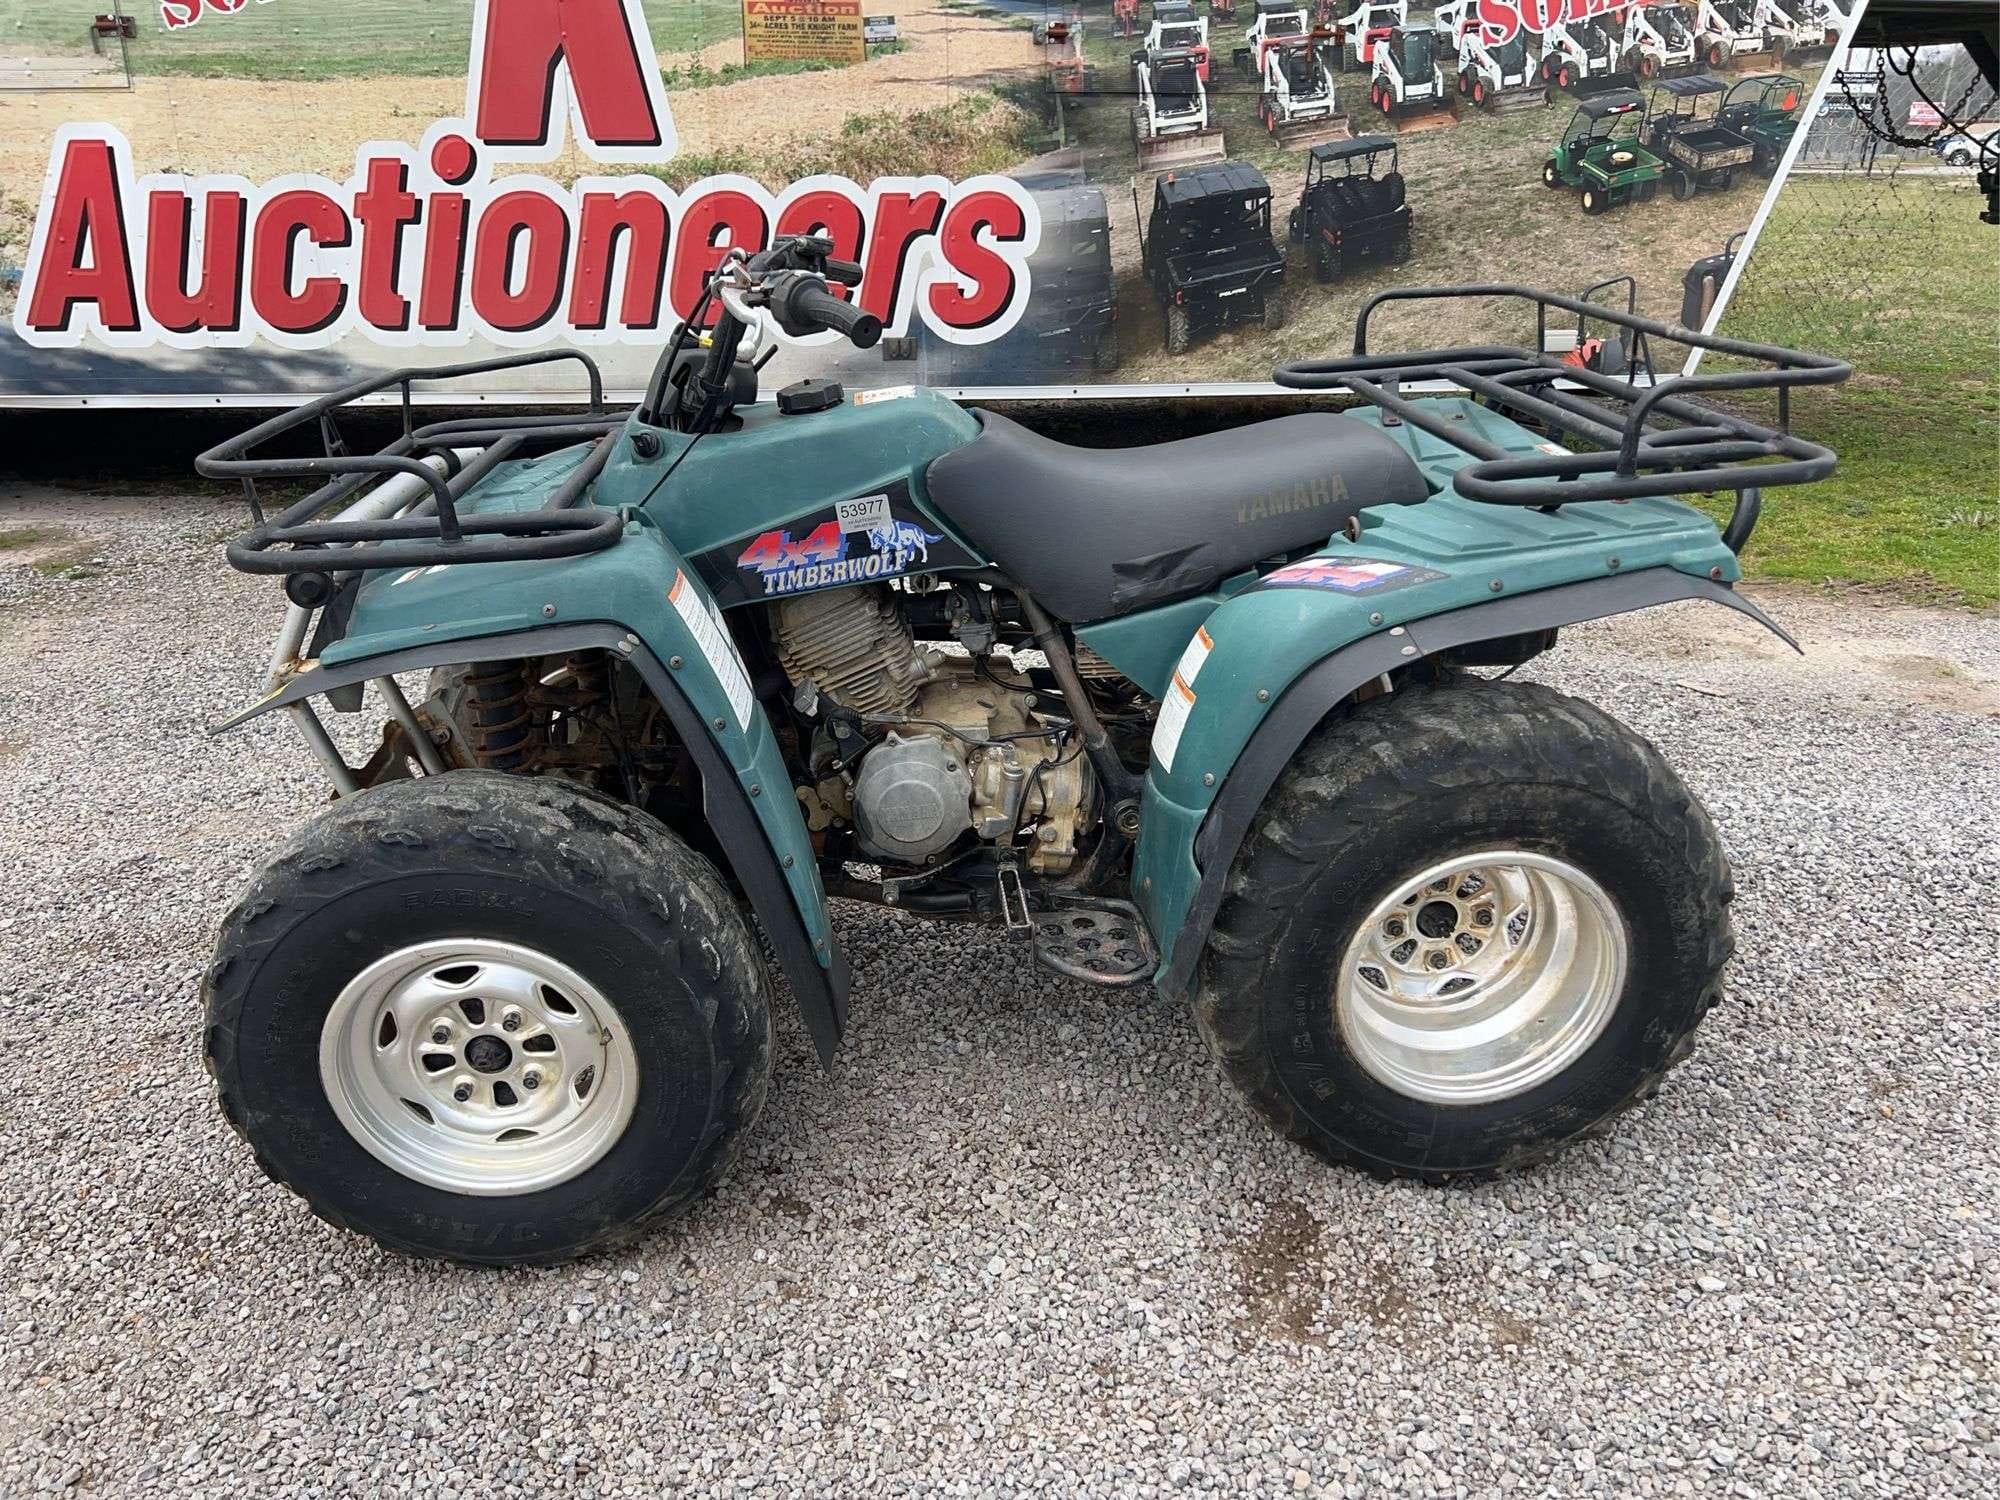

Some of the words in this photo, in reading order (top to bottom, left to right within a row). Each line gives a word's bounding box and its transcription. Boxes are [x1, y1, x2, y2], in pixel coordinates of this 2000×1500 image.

[752, 2, 855, 15] Auction
[764, 22, 789, 30] ACRES
[808, 23, 836, 31] KNIGHT
[838, 23, 858, 31] FARM
[27, 134, 1025, 332] Auctioneers
[840, 499, 884, 519] 53977
[1236, 472, 1350, 523] YAMAHA
[737, 520, 847, 572] 4x4
[763, 549, 908, 595] TIMBERWOLF
